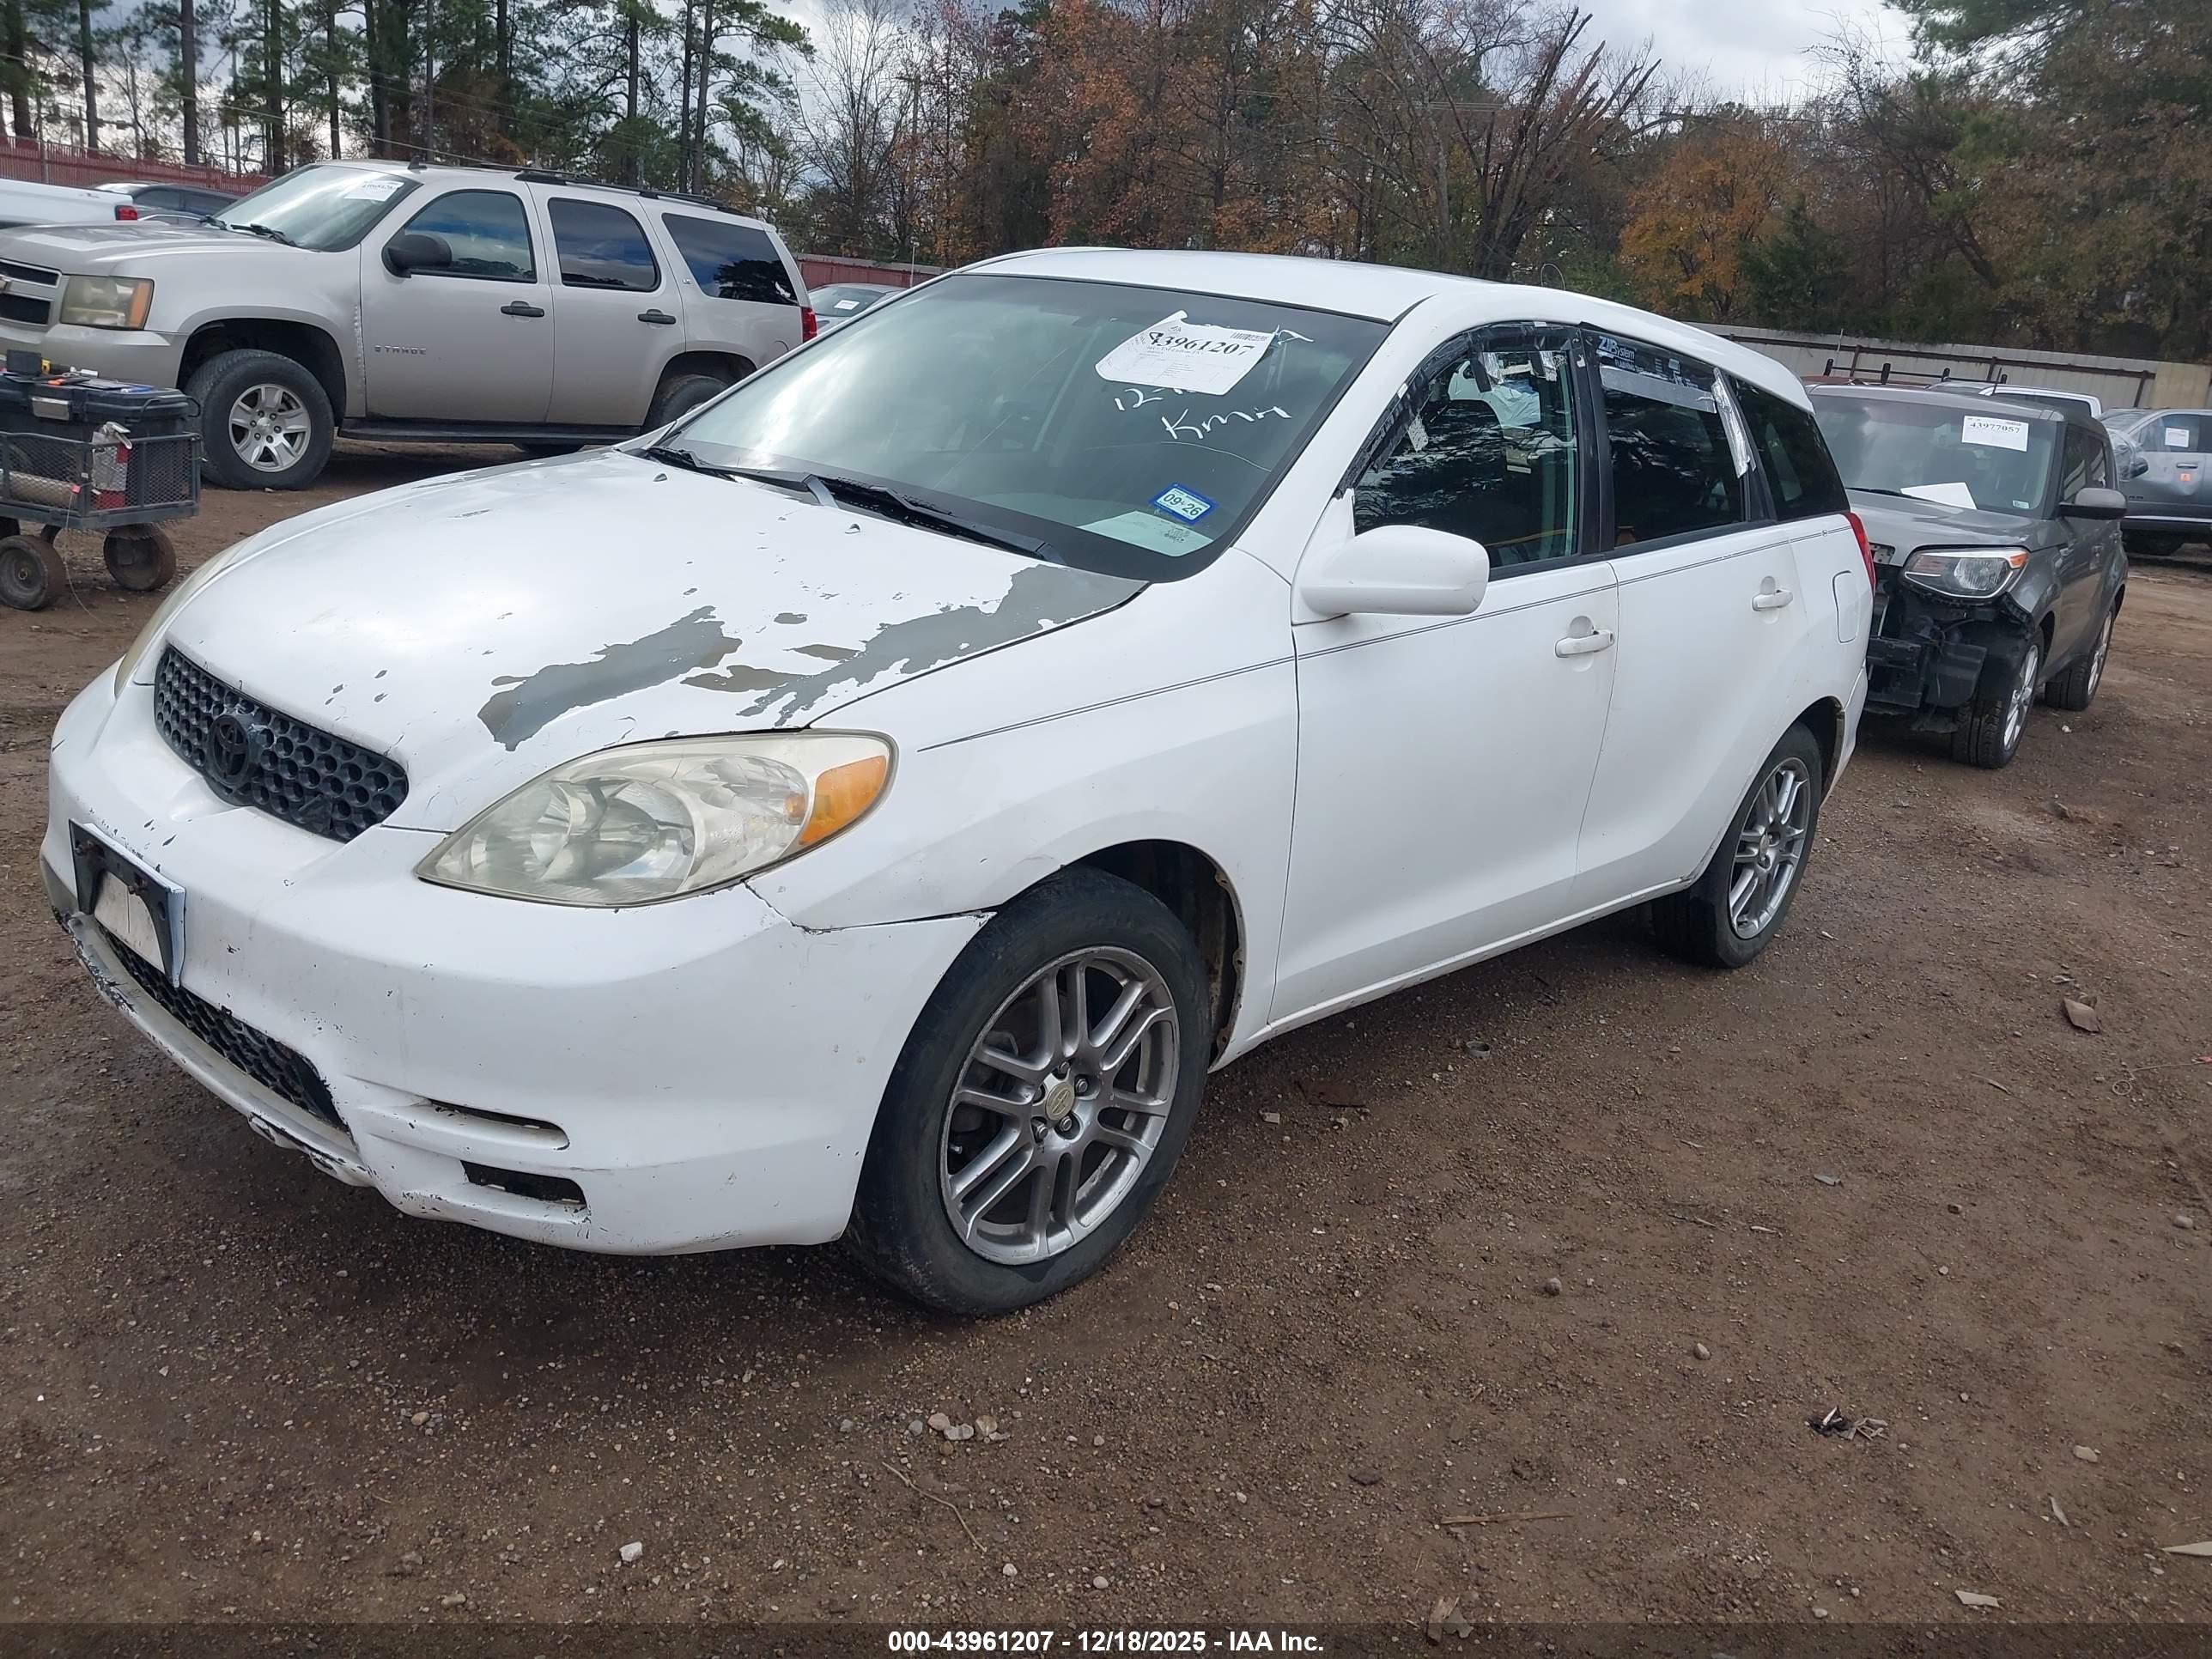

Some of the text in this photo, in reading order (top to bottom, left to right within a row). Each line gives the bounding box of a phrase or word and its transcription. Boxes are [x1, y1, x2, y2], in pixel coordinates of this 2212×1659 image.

[1148, 331, 1255, 356] 43961207
[1970, 422, 2021, 433] 43977057
[1163, 493, 1182, 506] 09
[1181, 502, 1203, 516] 26
